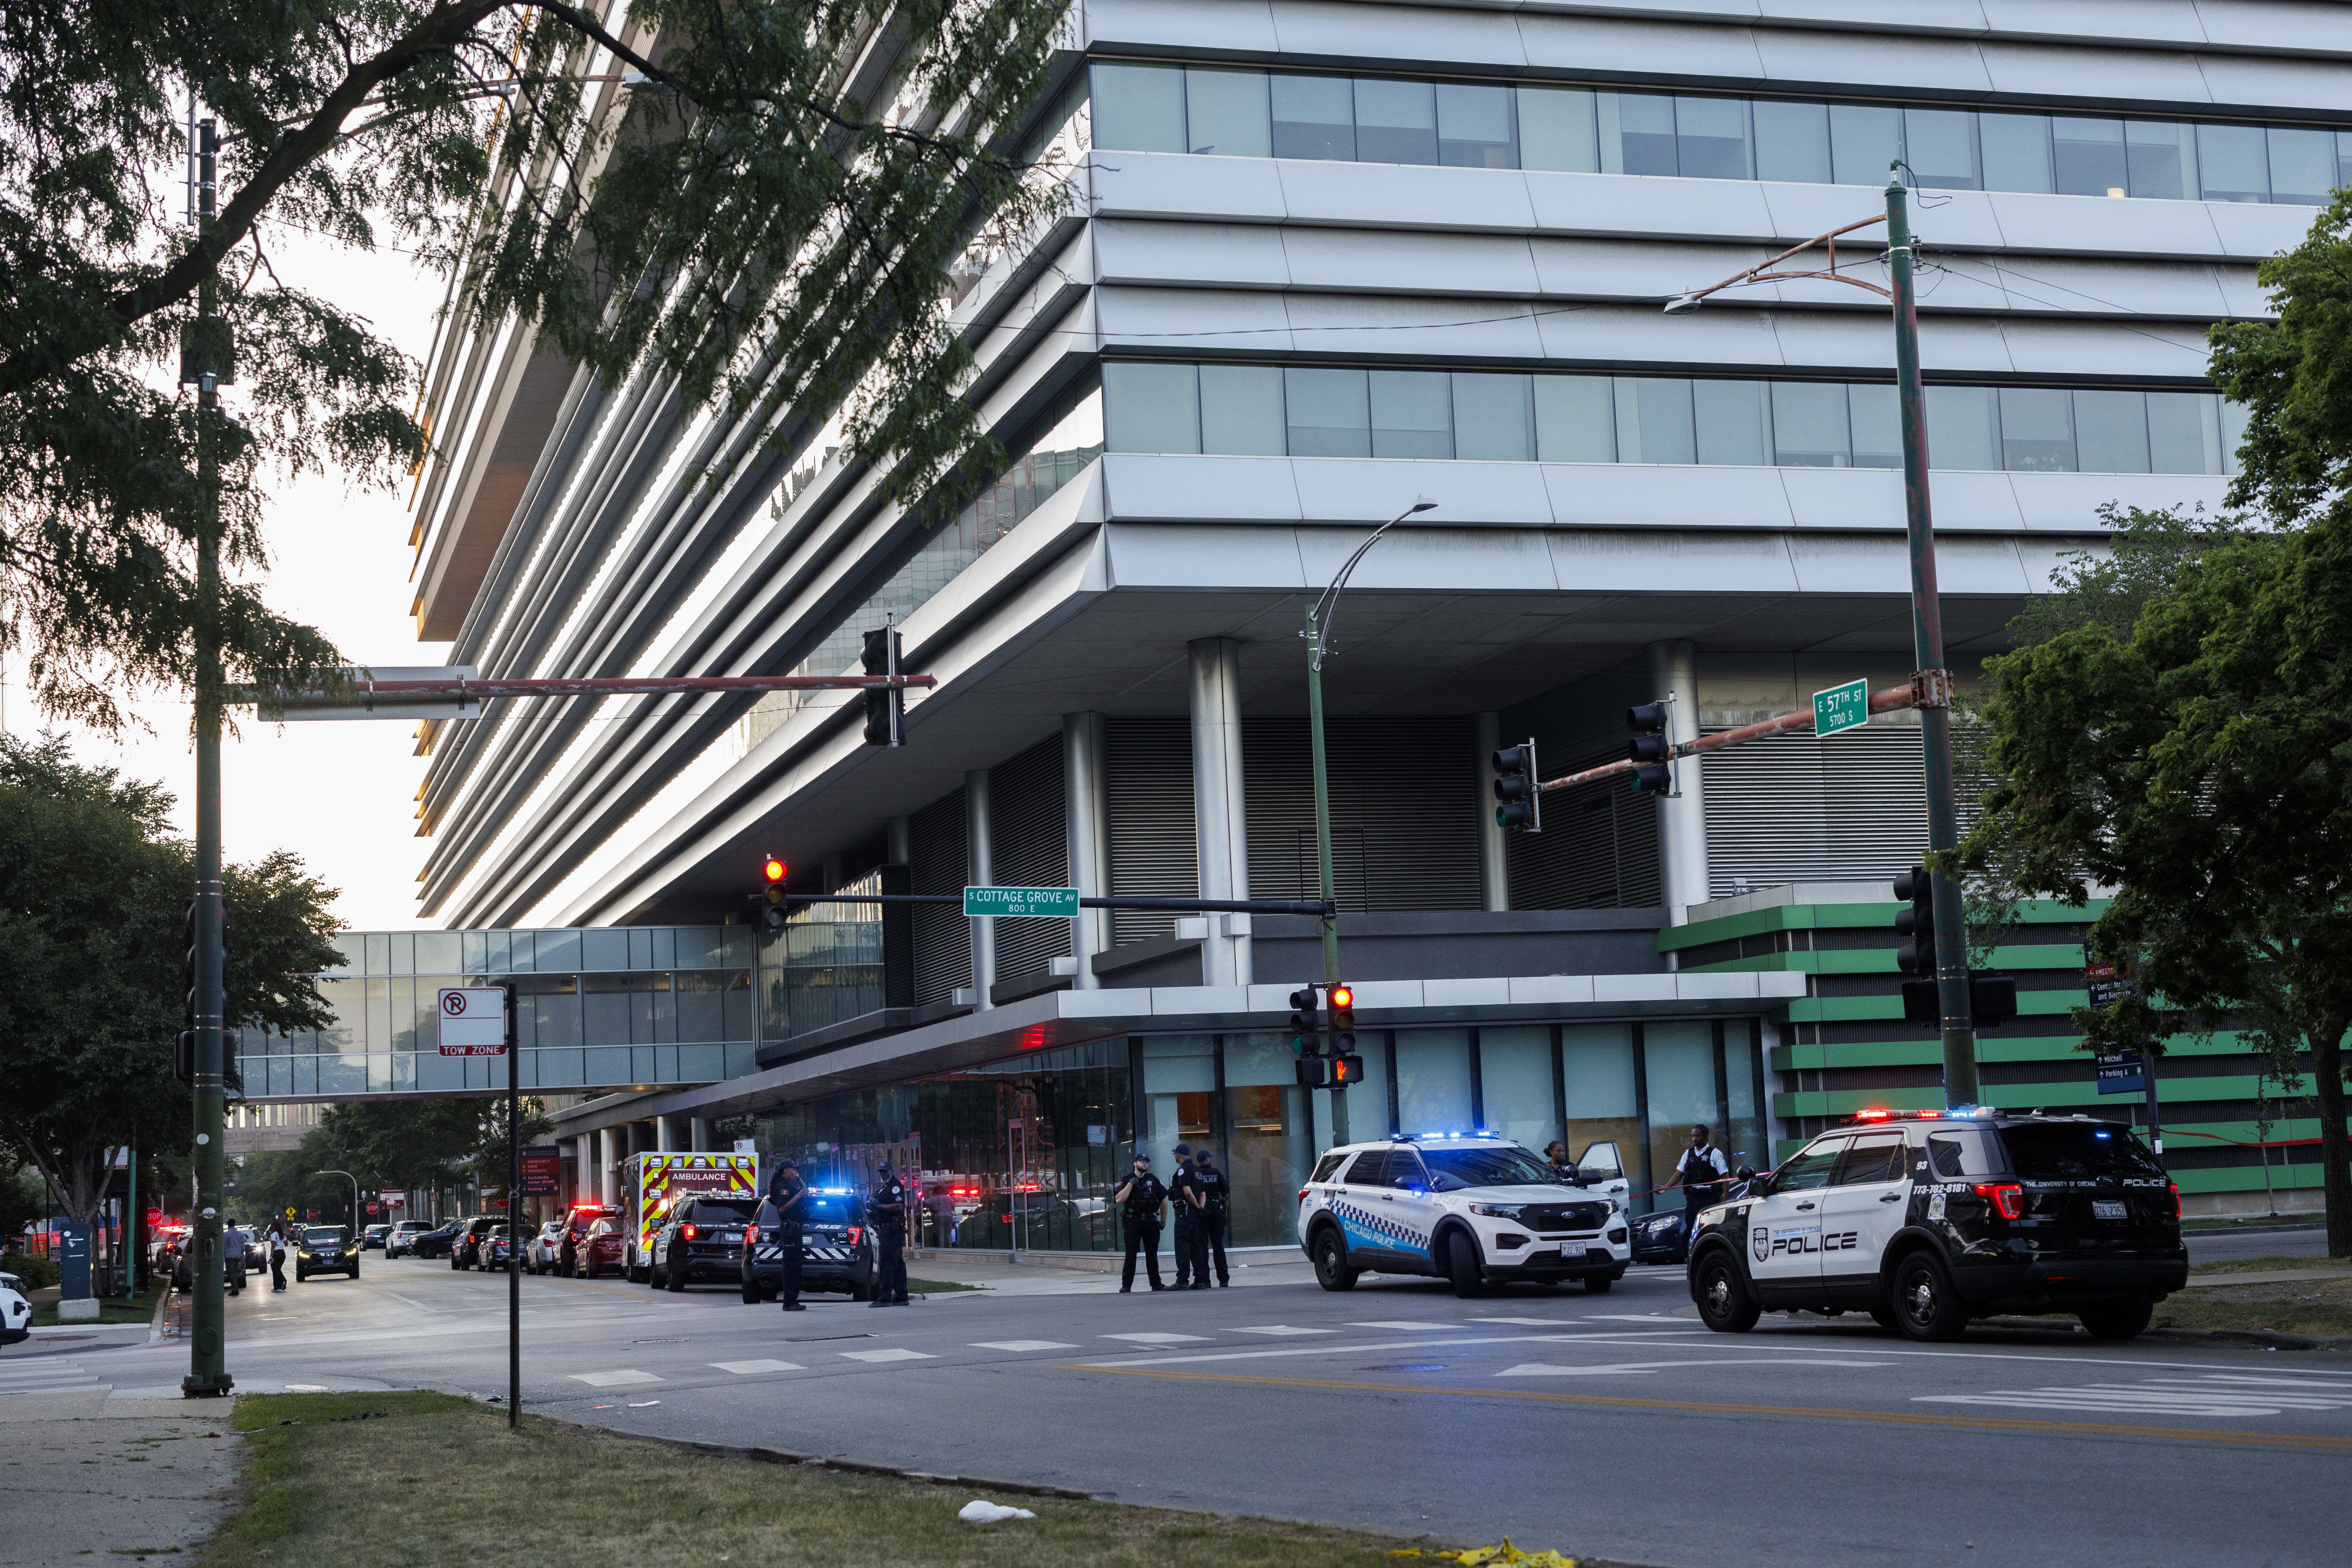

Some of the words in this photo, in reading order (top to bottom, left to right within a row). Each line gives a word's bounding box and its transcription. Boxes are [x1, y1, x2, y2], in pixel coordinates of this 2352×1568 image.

[1819, 701, 1823, 713] E
[1827, 690, 1850, 713] 57TH
[1854, 689, 1862, 702] ST
[1830, 712, 1845, 727] 5700
[1849, 710, 1853, 721] S
[969, 892, 974, 900] S
[977, 890, 1024, 903] COTTAGE
[1027, 891, 1063, 903] GROVE
[1008, 904, 1025, 912] 800
[443, 1046, 466, 1055] TOW
[472, 1045, 500, 1055] ZONE
[2104, 1054, 2123, 1063] Mitchell
[2106, 1069, 2123, 1078] Parking
[1916, 1161, 1928, 1171] 93
[2123, 1179, 2166, 1188] POLICE
[1913, 1183, 1967, 1195] 773-702-8181
[1738, 1206, 1747, 1215] 93
[1390, 1214, 1401, 1223] Serve
[1406, 1220, 1421, 1229] Protect
[1344, 1220, 1372, 1240] CHICAGO
[1373, 1231, 1396, 1250] POLICE
[1781, 1227, 1800, 1236] UNIVERSITY
[1772, 1231, 1858, 1256] POLICE
[1575, 1246, 1584, 1254] 921
